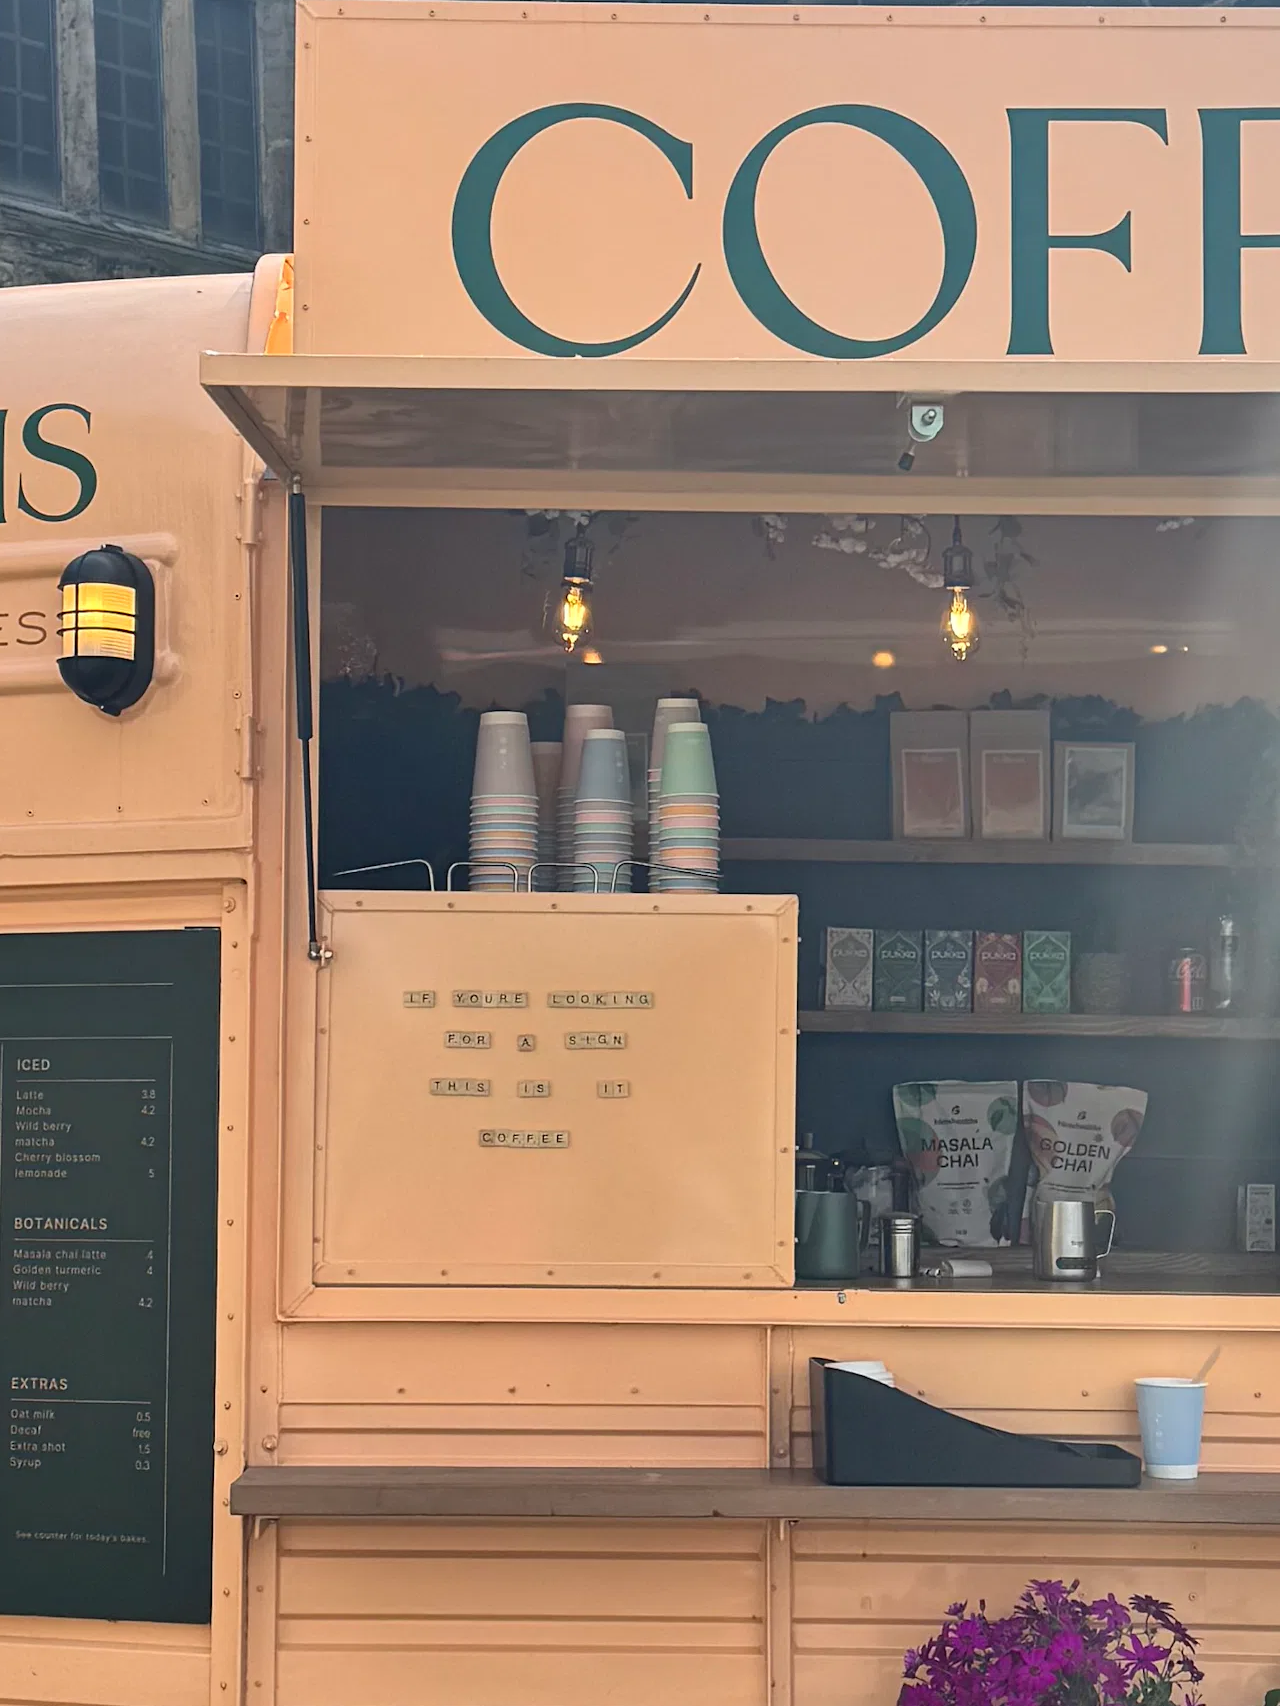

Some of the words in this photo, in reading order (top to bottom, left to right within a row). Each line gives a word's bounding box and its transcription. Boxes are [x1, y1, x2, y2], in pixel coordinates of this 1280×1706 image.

[881, 950, 916, 959] pukka
[931, 950, 966, 959] pukka
[982, 951, 1016, 960] pukka
[1030, 951, 1065, 960] pukka
[410, 995, 431, 1003] IF
[456, 994, 522, 1004] YOURE
[552, 994, 648, 1004] LOOKING
[448, 1034, 485, 1044] FOR
[569, 1035, 621, 1045] SIGN
[18, 1059, 50, 1070] ICED
[435, 1081, 485, 1092] THIS
[525, 1084, 544, 1093] IS
[605, 1084, 623, 1093] IT
[17, 1090, 43, 1100] Latte
[142, 1090, 155, 1099] 3.8
[16, 1106, 51, 1115] Mocha
[141, 1105, 155, 1115] 4.2
[16, 1121, 38, 1130] Wild
[43, 1122, 71, 1132] berry
[15, 1138, 54, 1146] matcha
[141, 1137, 154, 1146] 4.2
[483, 1132, 563, 1144] COFFEE
[922, 1138, 993, 1152] MASALA
[1040, 1138, 1110, 1160] GOLDEN
[15, 1152, 51, 1164] Cherry
[56, 1153, 100, 1162] blossom
[937, 1155, 978, 1168] CHAI
[1052, 1157, 1093, 1173] CHAI
[15, 1169, 67, 1177] lemonade
[149, 1169, 154, 1178] 5
[15, 1218, 107, 1230] BOTANICALS
[14, 1249, 51, 1259] Masala
[56, 1250, 78, 1259] chai
[82, 1250, 106, 1259] latte
[13, 1264, 51, 1274] Golden
[56, 1265, 101, 1275] turmeric
[147, 1266, 152, 1274] 4
[13, 1280, 36, 1290] Wild
[40, 1281, 69, 1292] berry
[13, 1297, 51, 1306] matcha
[139, 1298, 153, 1307] 4.2
[12, 1377, 67, 1390] EXTRAS
[11, 1409, 30, 1418] Oat
[33, 1410, 54, 1419] milk
[137, 1412, 150, 1422] 0.5
[11, 1425, 41, 1435] Decaf
[133, 1427, 150, 1438] free
[10, 1441, 37, 1451] Extra
[42, 1442, 65, 1452] shot
[139, 1444, 150, 1454] 1.5
[10, 1457, 41, 1469] Syrup
[135, 1460, 150, 1470] 0.3
[16, 1530, 30, 1538] See
